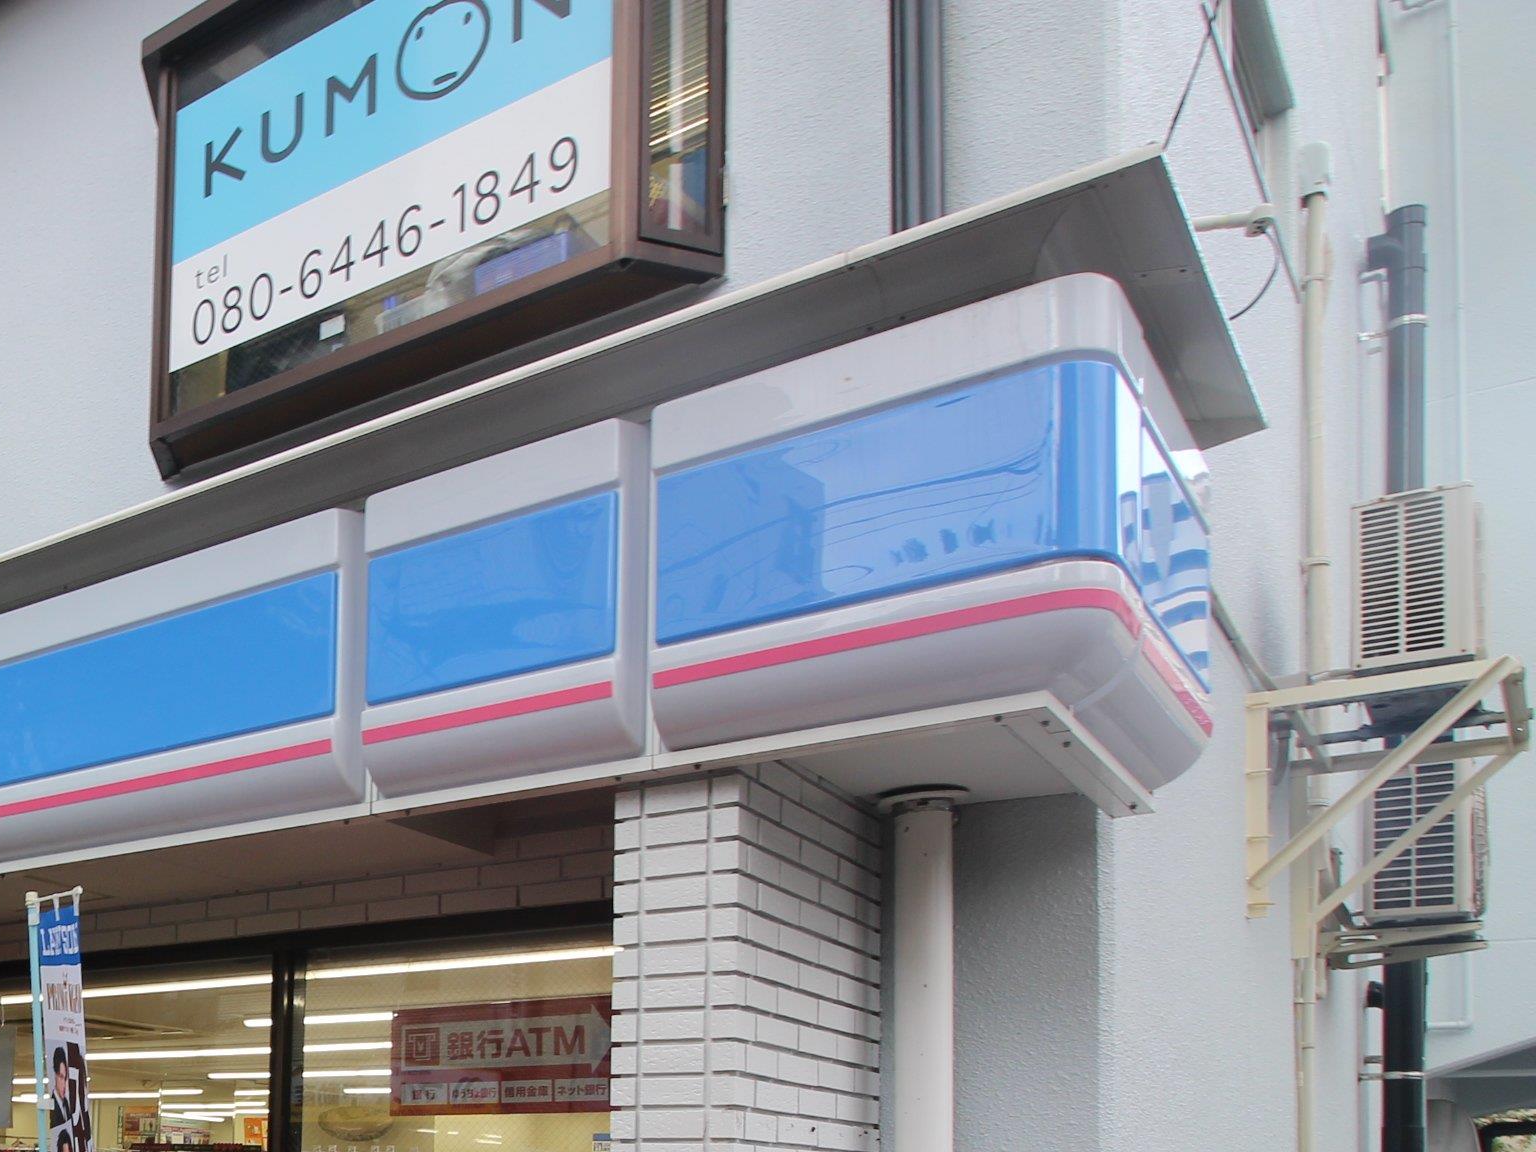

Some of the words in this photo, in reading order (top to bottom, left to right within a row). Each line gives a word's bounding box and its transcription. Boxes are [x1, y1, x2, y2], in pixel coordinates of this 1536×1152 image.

[192, 136, 580, 346] 080-6446-1849
[195, 254, 229, 291] tel
[446, 1024, 586, 1061] 銀行ATM
